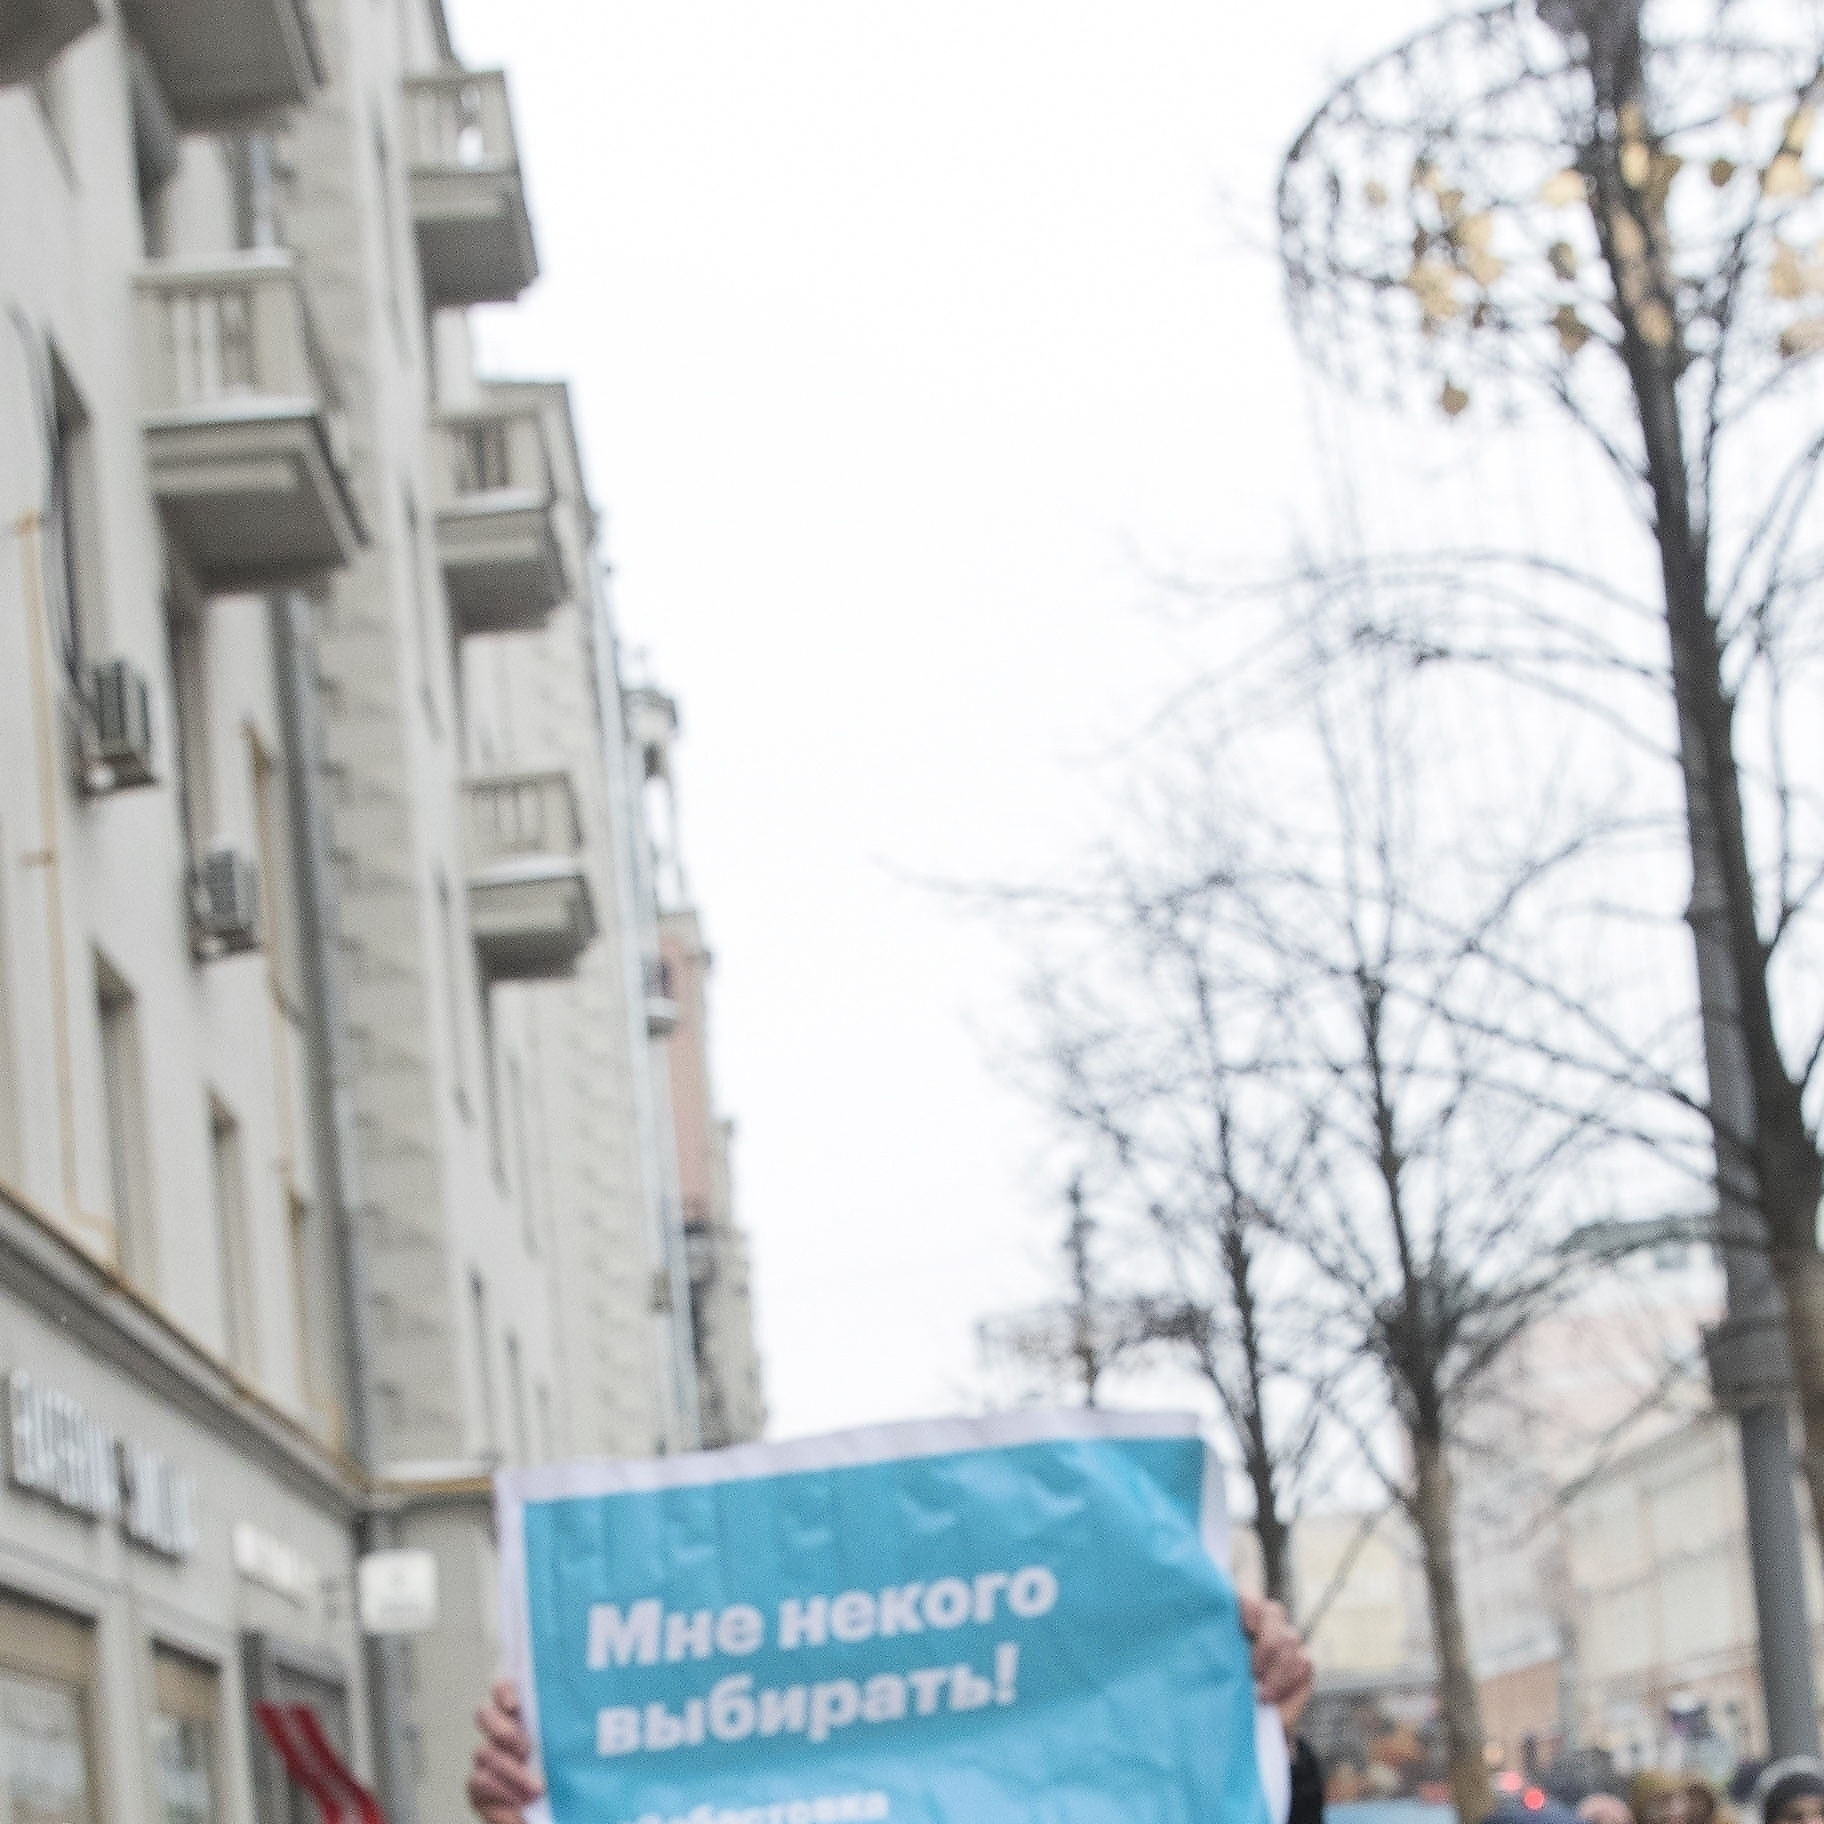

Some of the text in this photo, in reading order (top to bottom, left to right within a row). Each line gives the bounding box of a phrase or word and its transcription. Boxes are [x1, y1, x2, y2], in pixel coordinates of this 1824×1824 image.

[587, 1565, 1058, 1671] Мне некого
[597, 1641, 1019, 1759] выбирать!
